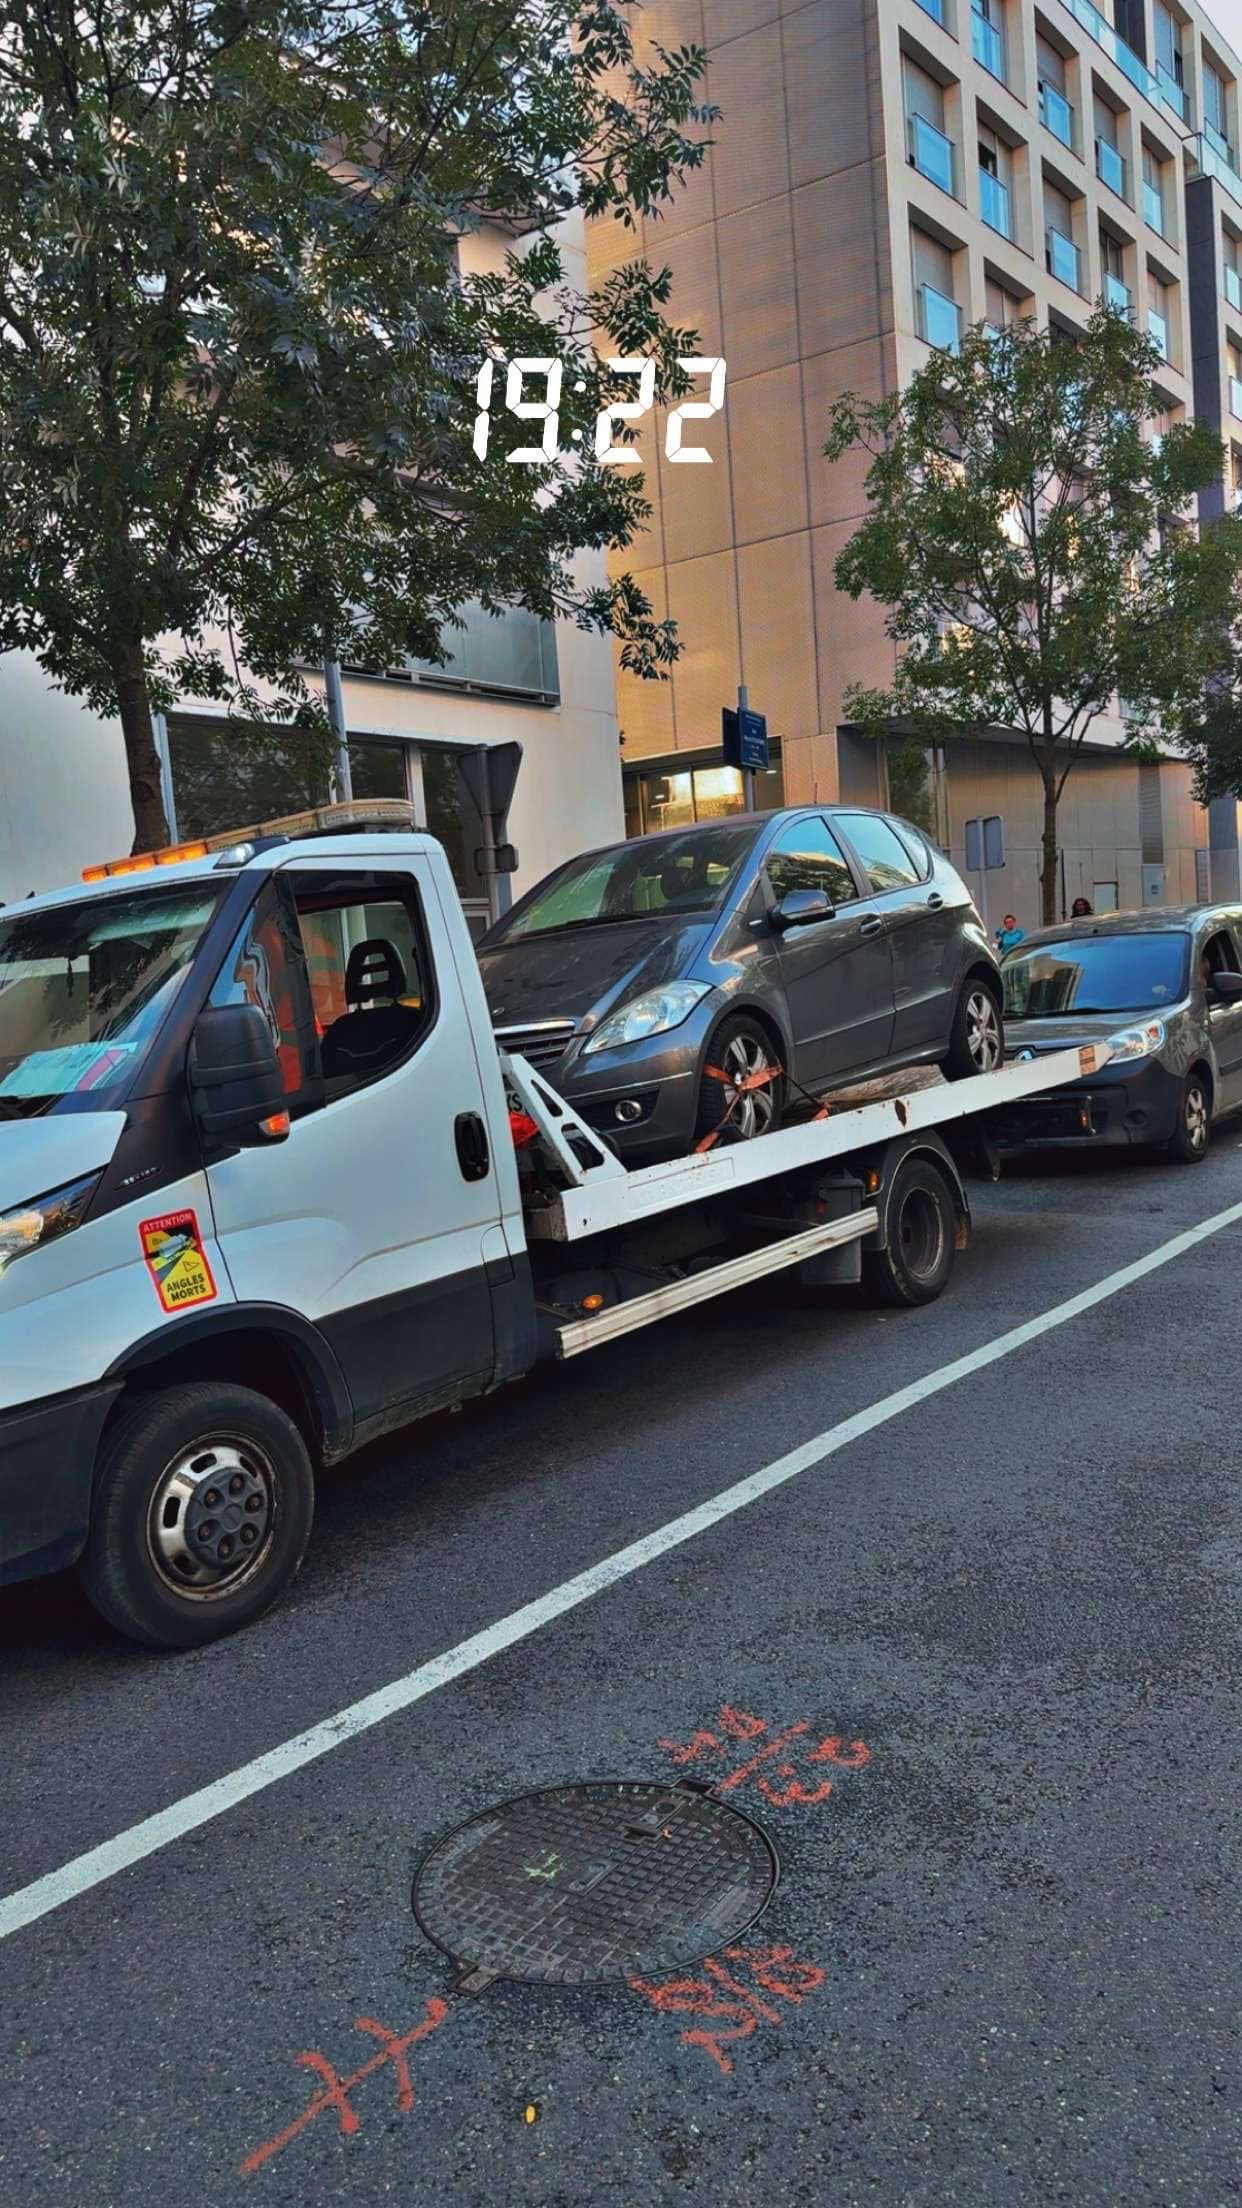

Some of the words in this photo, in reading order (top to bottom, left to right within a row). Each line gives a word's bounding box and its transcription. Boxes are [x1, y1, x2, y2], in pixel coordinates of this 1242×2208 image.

[143, 1212, 193, 1233] ATTENTION
[166, 1272, 205, 1293] ANGLES
[170, 1283, 207, 1302] MORTS
